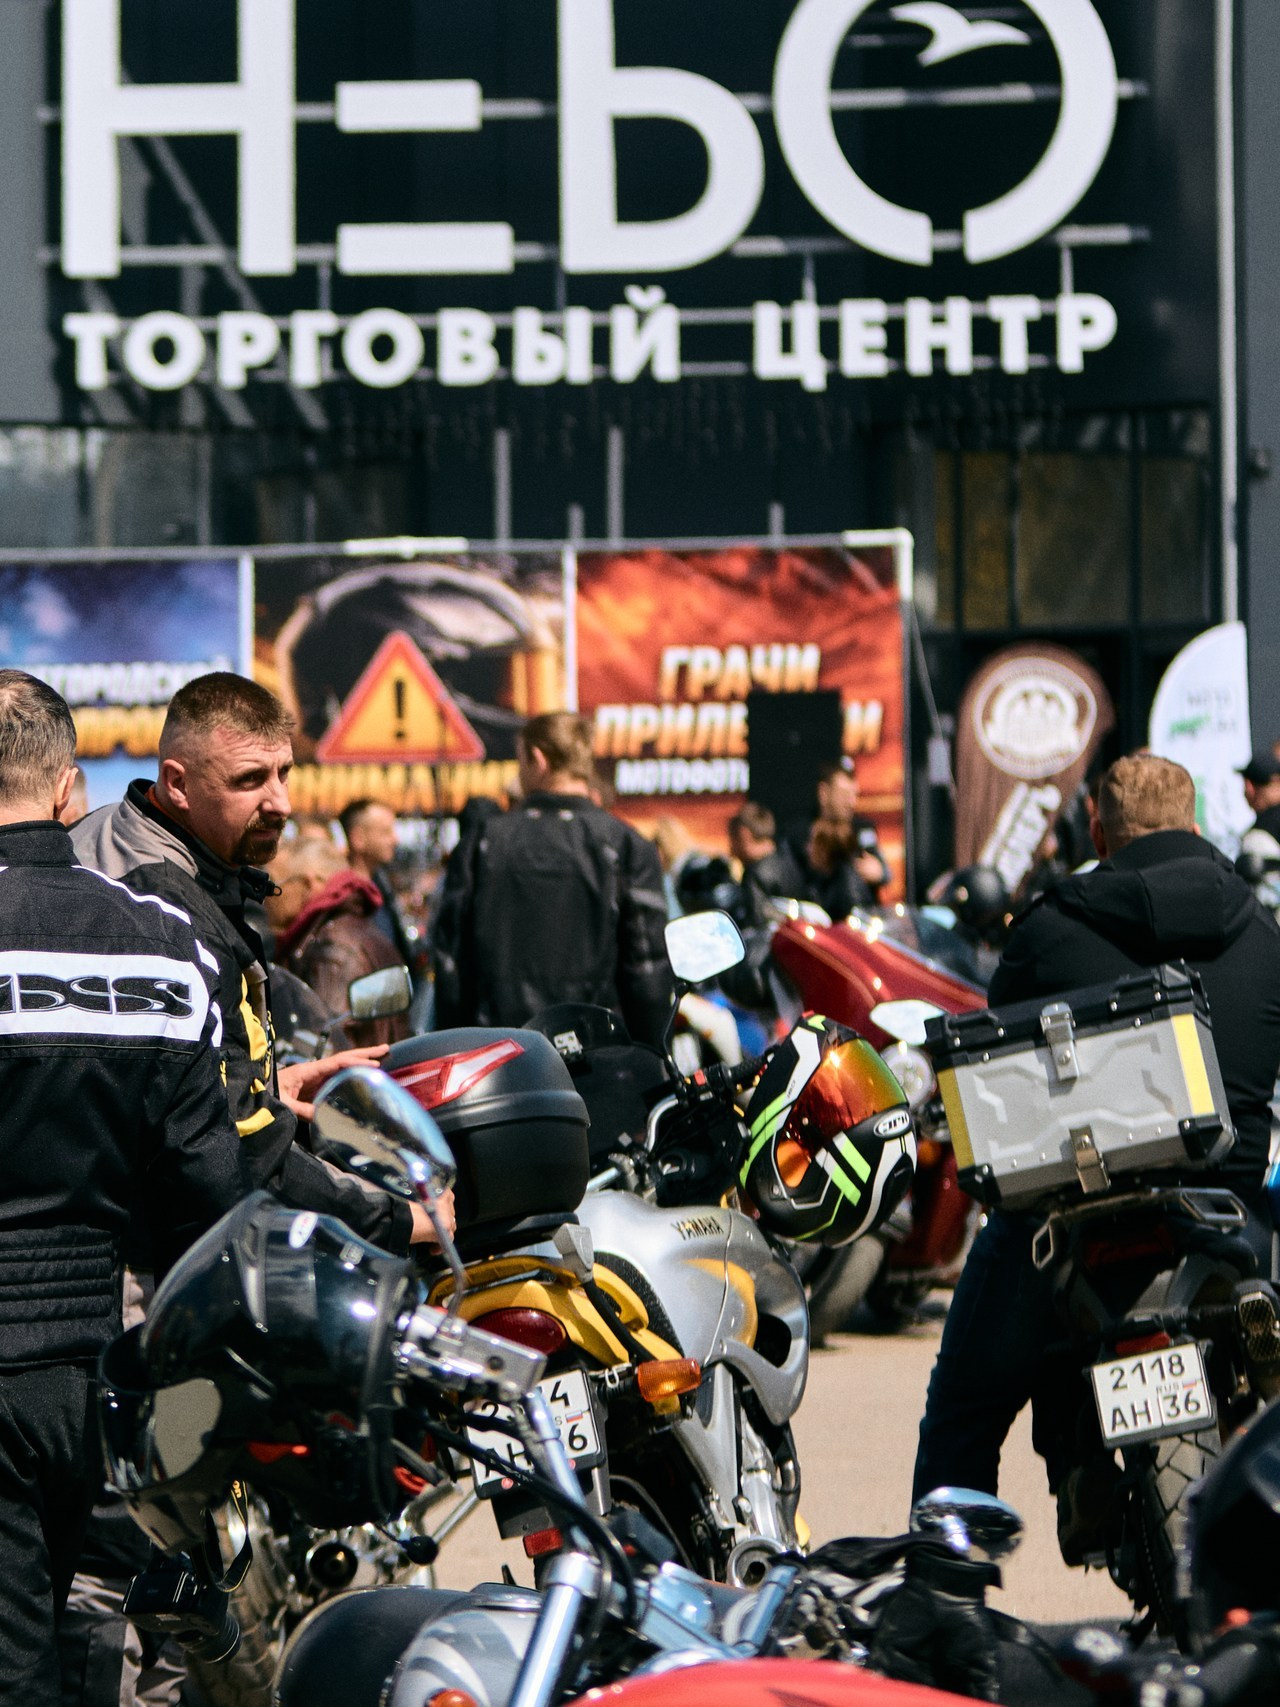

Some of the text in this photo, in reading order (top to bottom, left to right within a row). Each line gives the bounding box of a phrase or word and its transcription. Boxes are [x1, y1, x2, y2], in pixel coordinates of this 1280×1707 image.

[64, 286, 1117, 391] ТОРГОВЫЙ ЦЕНТР
[659, 642, 821, 700] ГРАЧИ
[594, 700, 883, 756] ПРИЛЕИ
[1109, 1353, 1185, 1392] 2118
[1163, 1390, 1201, 1419] 36
